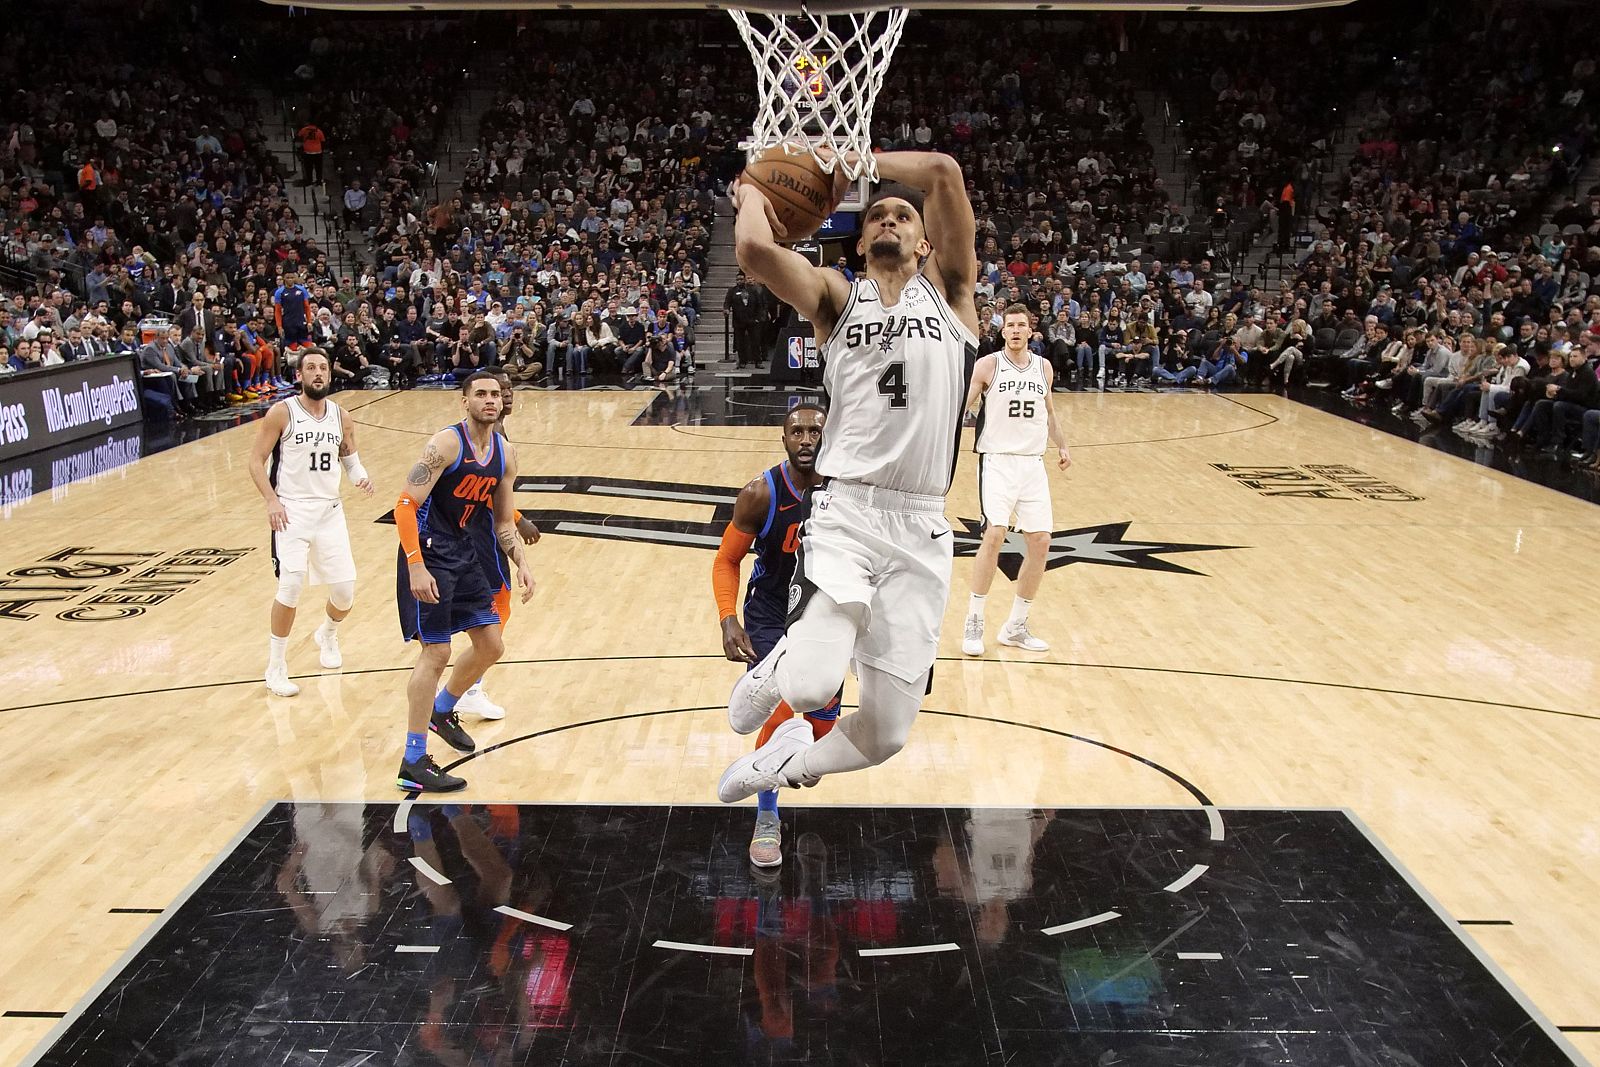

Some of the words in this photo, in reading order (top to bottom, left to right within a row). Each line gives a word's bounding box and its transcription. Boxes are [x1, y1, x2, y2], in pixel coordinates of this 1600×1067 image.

[846, 315, 942, 354] SPURS
[876, 361, 909, 410] 4
[999, 381, 1044, 395] SPURS
[42, 375, 138, 433] NBA.com/LeaguePass
[1008, 400, 1035, 419] 25
[295, 431, 340, 447] SPURS
[309, 452, 331, 471] 18
[453, 474, 498, 502] OKC
[56, 546, 257, 622] CENTER
